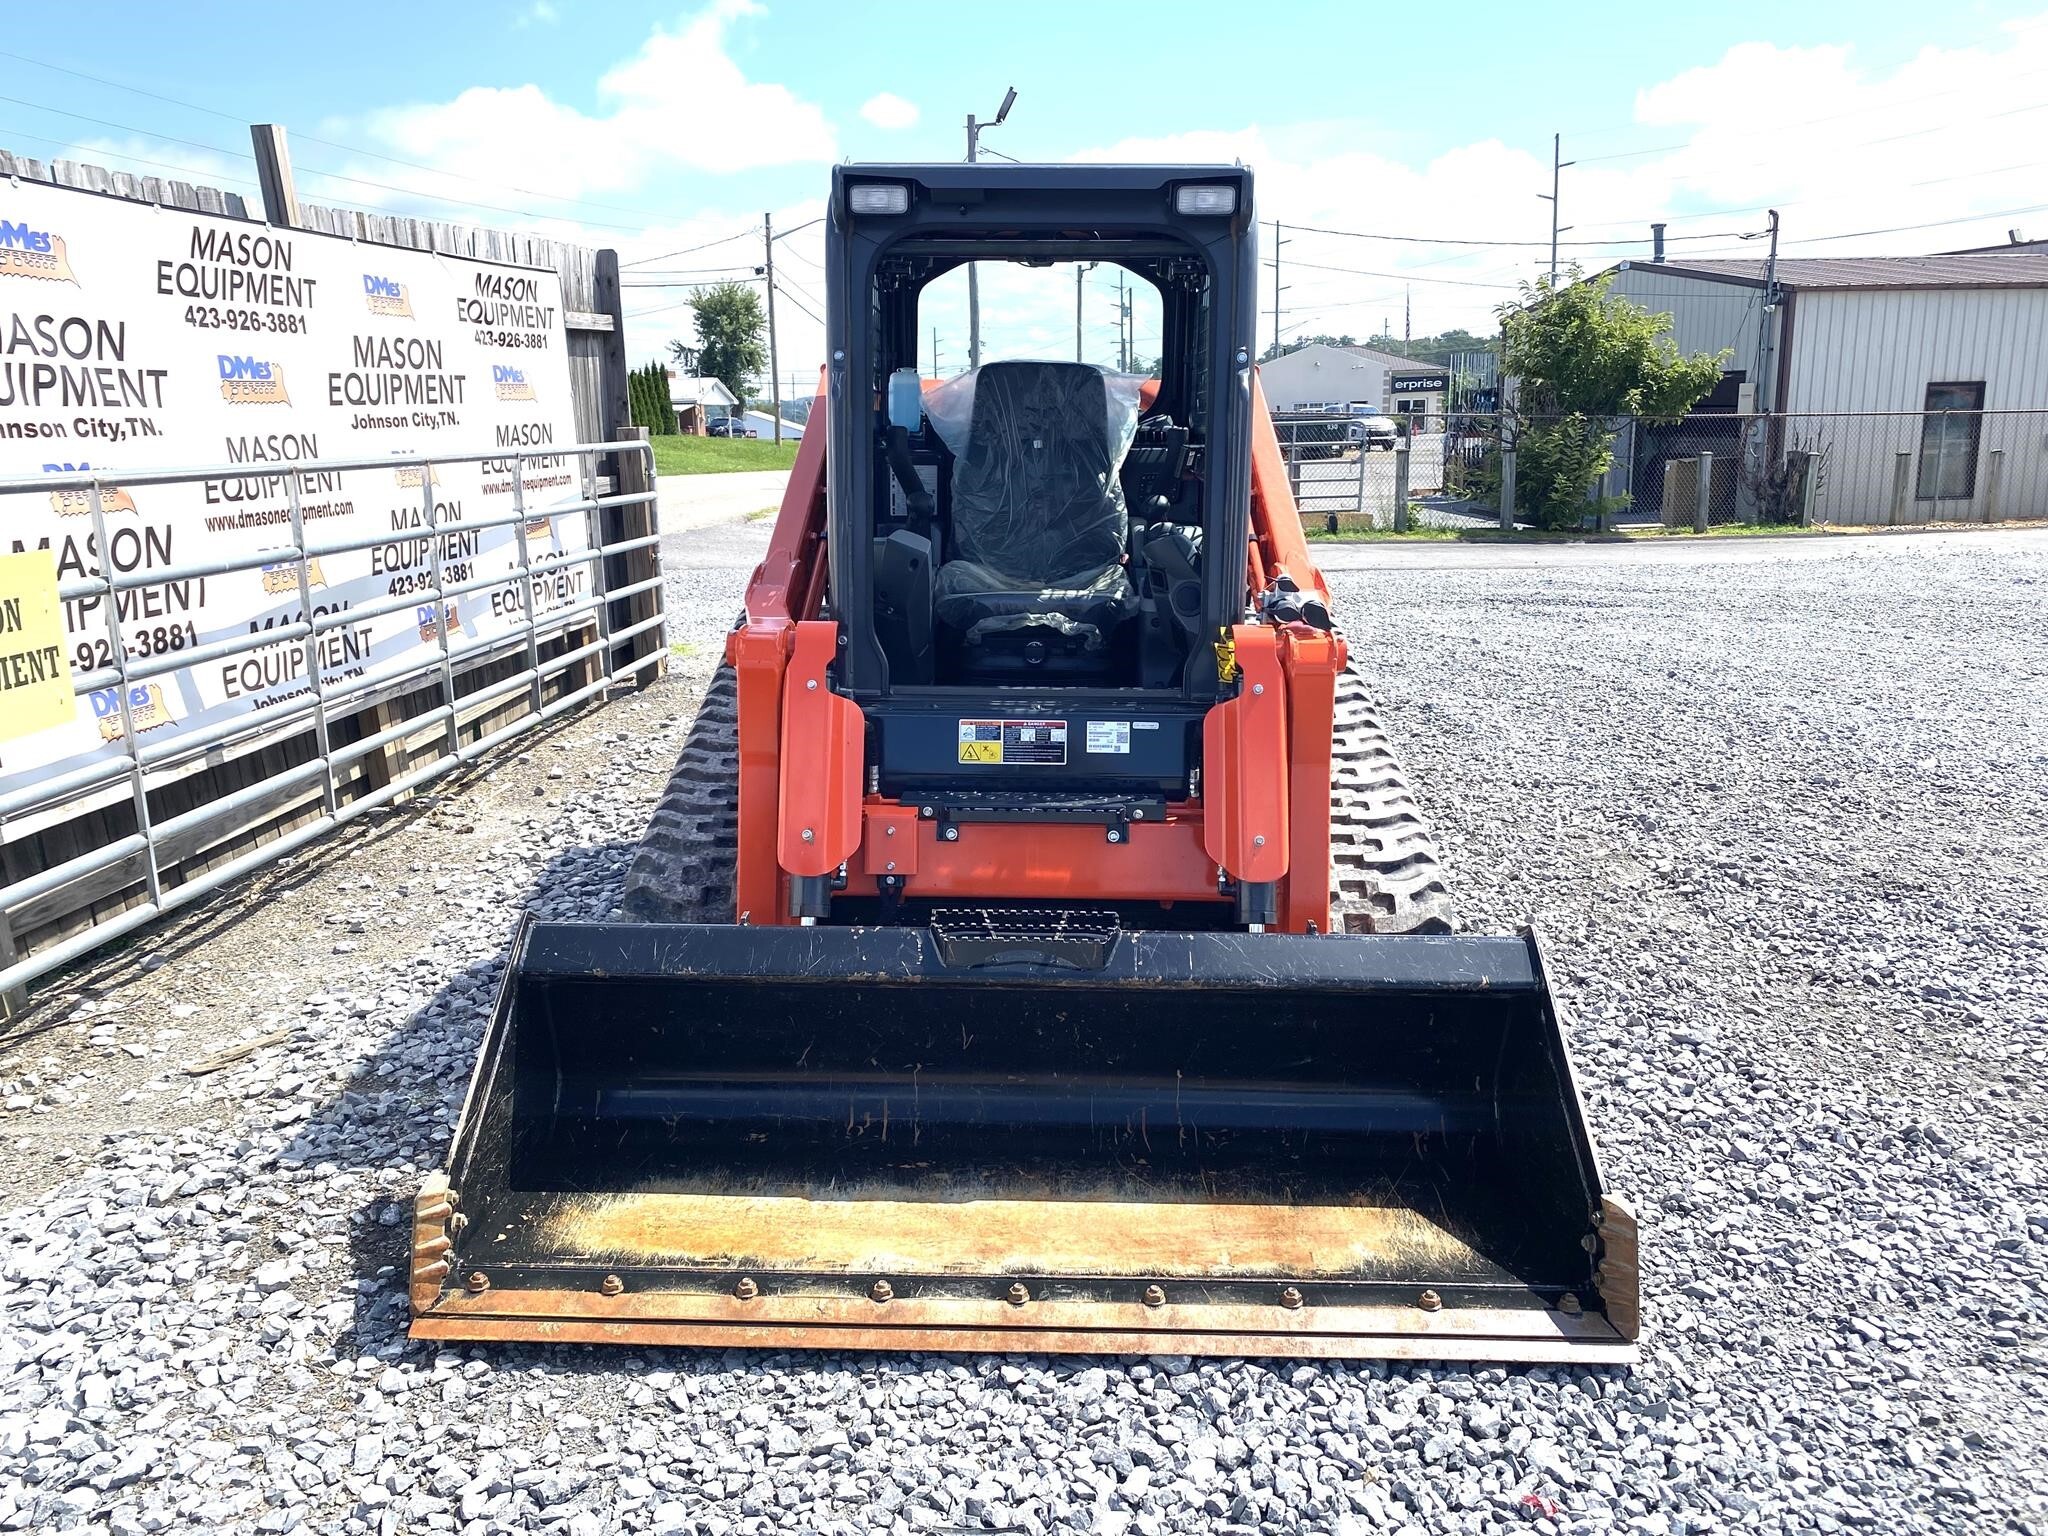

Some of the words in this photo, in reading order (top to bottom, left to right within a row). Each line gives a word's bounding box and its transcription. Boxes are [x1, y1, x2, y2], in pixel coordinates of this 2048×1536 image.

[190, 226, 292, 271] MASON
[157, 260, 317, 308] EQUIPMENT
[475, 273, 537, 303] MASON
[185, 305, 307, 334] 423-926-3881
[457, 297, 554, 330] EQUIPMENT
[0, 313, 125, 361] ASON
[353, 335, 442, 370] MASON
[475, 330, 548, 349] 423-926-3881
[0, 362, 168, 408] UIPMENT
[328, 373, 466, 406] EQUIPMENT
[1395, 378, 1443, 391] erprise
[351, 413, 409, 430] Johnson
[496, 422, 553, 448] MASON
[226, 433, 318, 463] MASON
[391, 500, 462, 531] MAON
[12, 524, 172, 581] ASON
[388, 561, 474, 597] 423-92-3881
[491, 570, 584, 618] EQUPMENT
[69, 620, 199, 672] -92-3881
